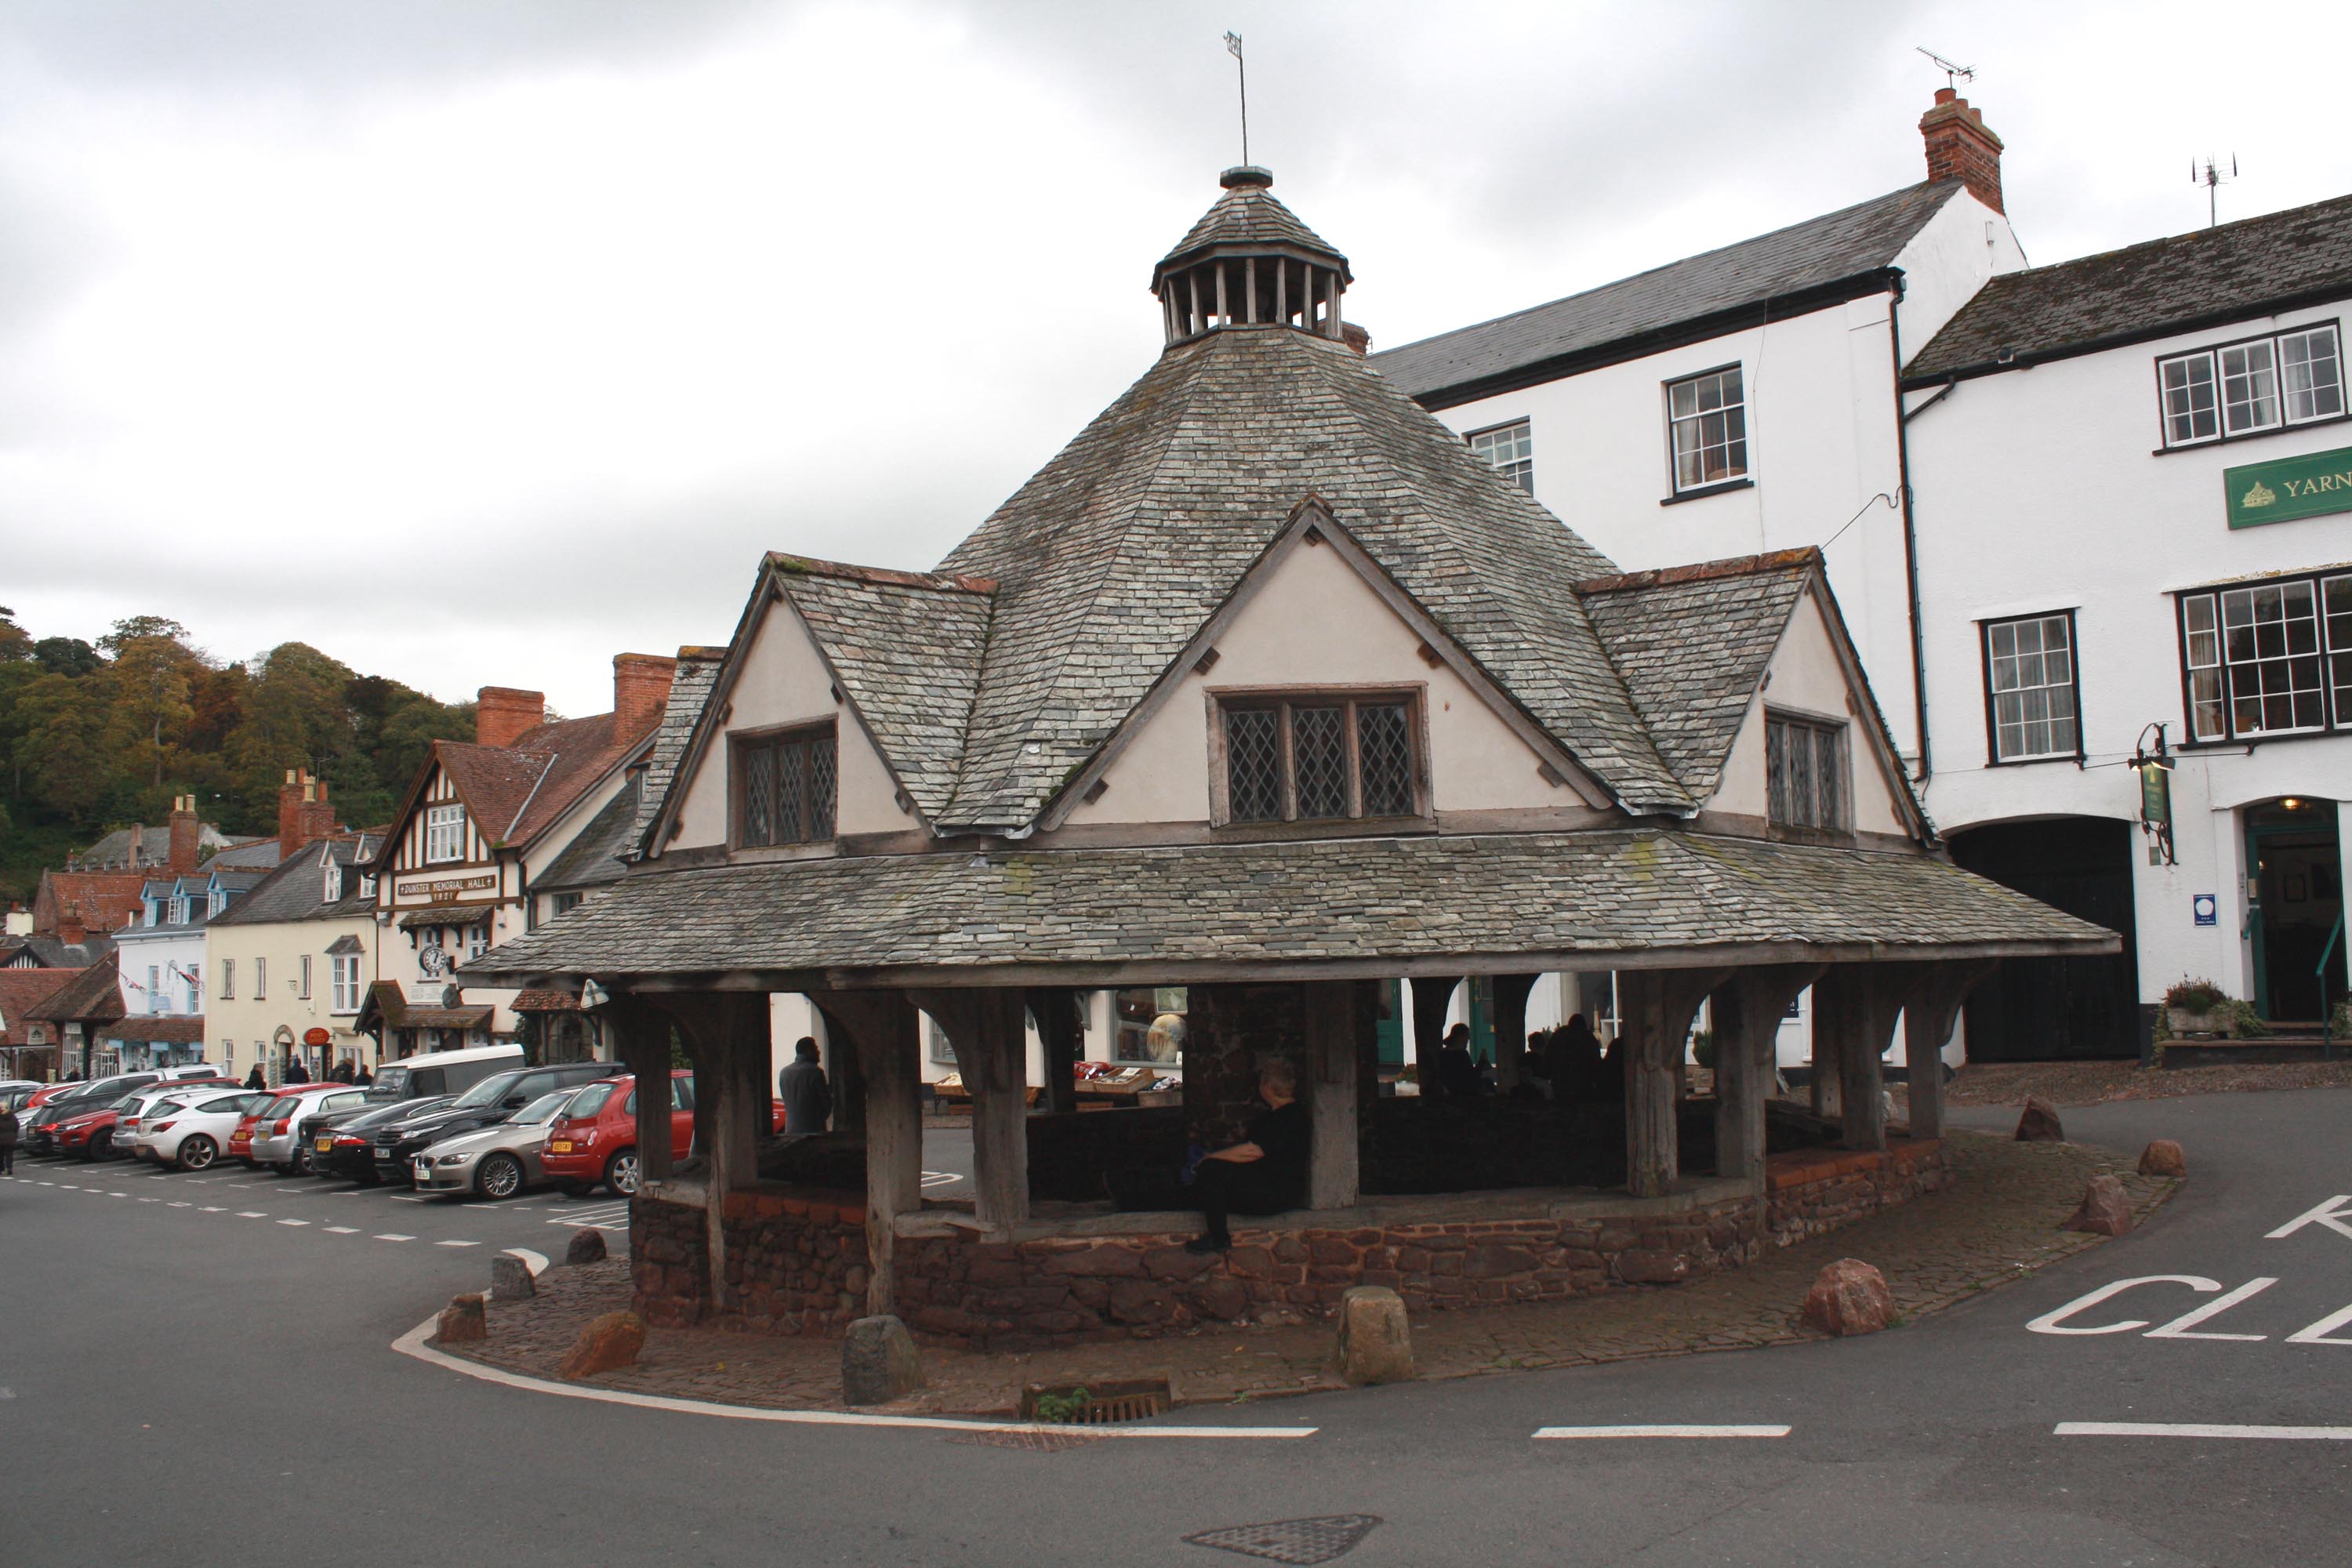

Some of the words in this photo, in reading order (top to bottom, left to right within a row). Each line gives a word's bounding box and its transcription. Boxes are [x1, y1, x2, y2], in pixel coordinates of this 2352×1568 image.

[2283, 471, 2352, 497] YARN
[405, 883, 430, 894] DUNSTER
[433, 879, 464, 891] MEMORIAL
[468, 877, 485, 888] HALL
